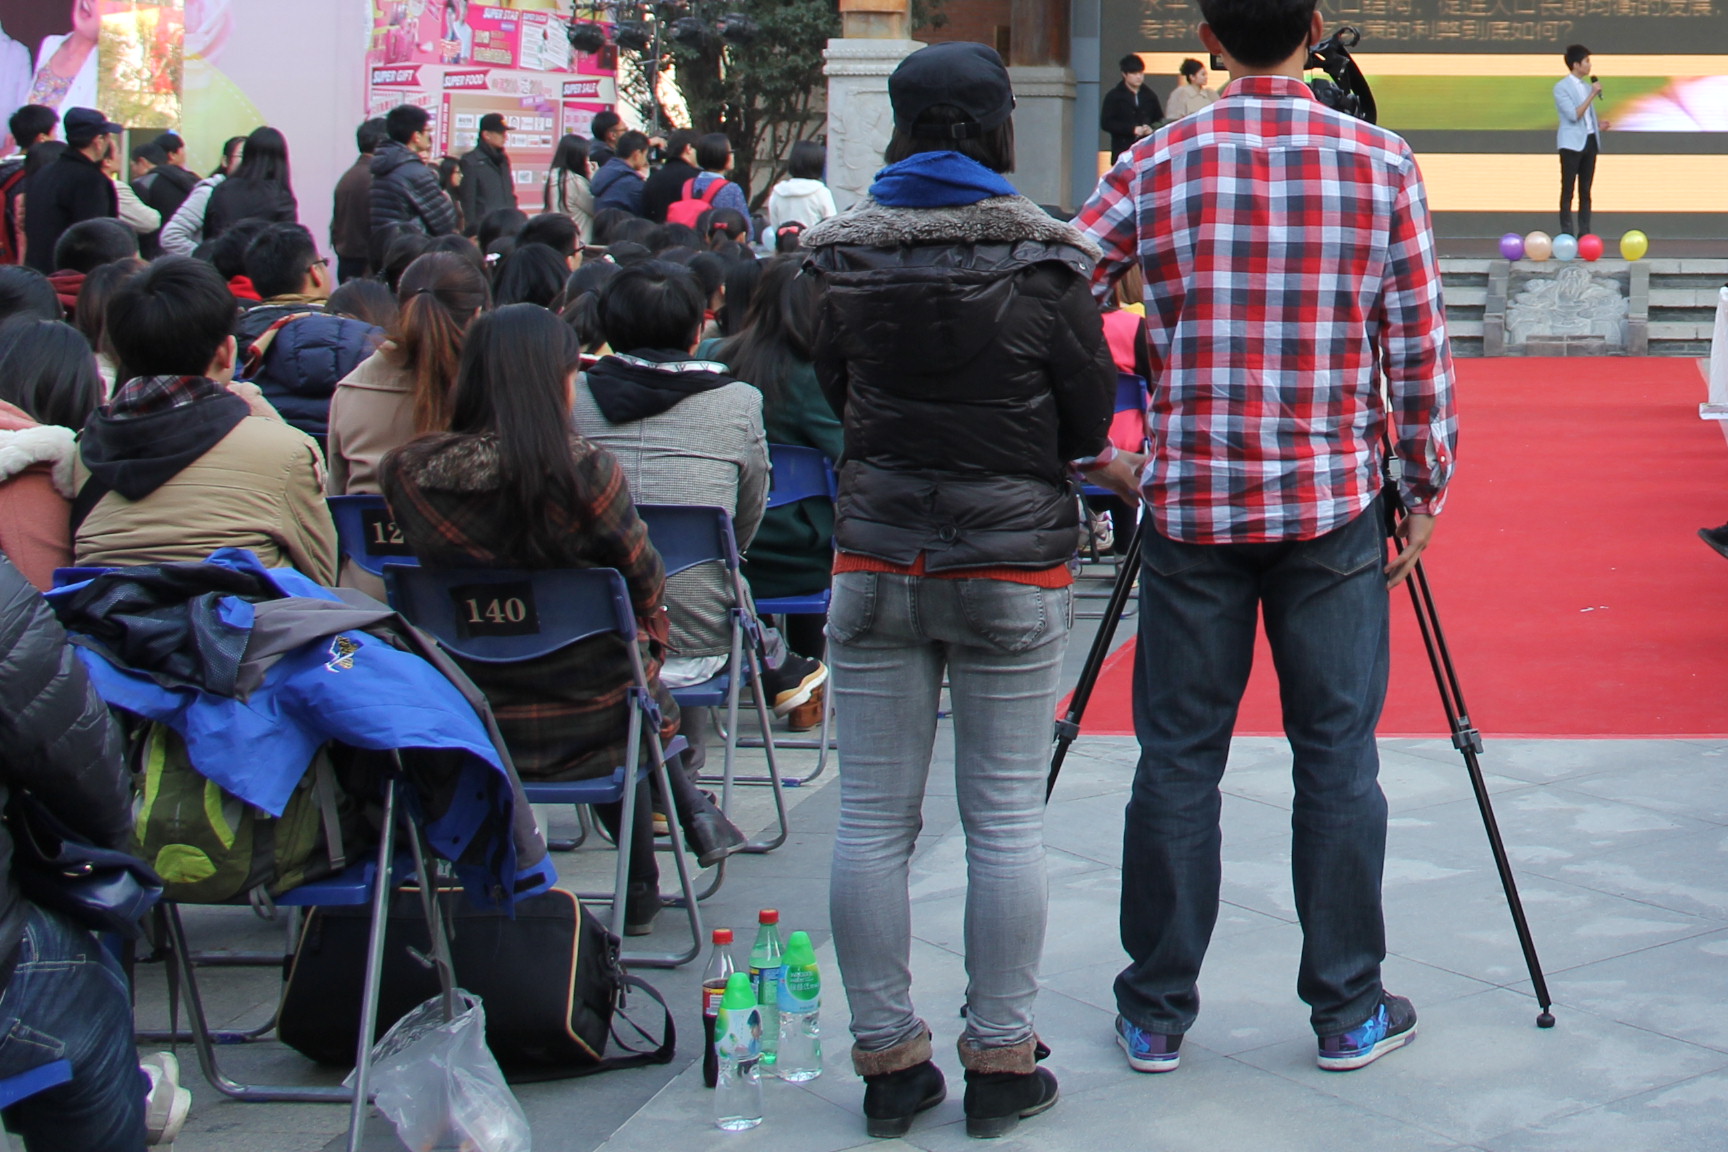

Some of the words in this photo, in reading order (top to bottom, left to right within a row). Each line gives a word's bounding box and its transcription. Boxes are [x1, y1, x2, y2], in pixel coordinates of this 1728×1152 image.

[373, 70, 397, 84] SUPER
[444, 75, 465, 87] SUPER
[373, 522, 404, 544] 12
[466, 598, 526, 623] 140
